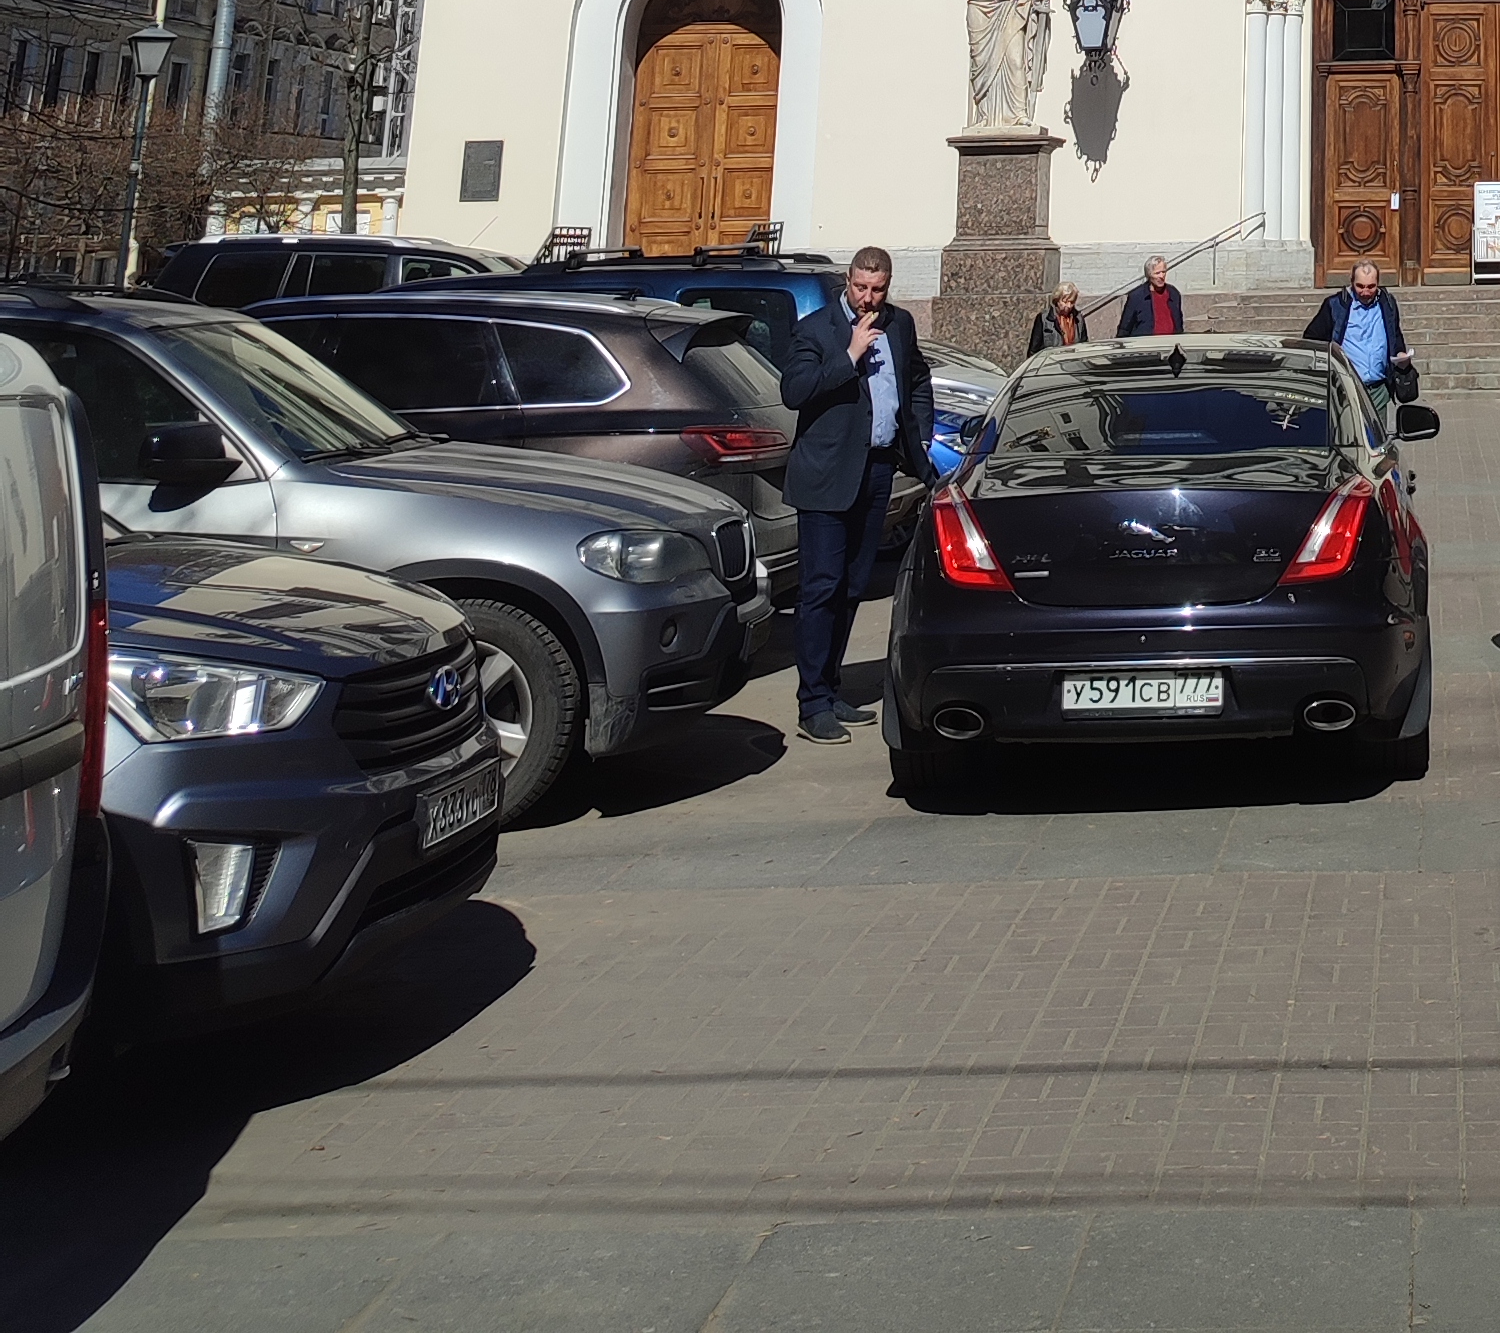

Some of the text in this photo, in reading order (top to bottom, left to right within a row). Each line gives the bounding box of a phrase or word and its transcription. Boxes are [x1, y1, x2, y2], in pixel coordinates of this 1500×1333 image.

[1109, 548, 1179, 559] JAGUAR
[1073, 672, 1216, 704] У591СВ 777
[1186, 694, 1205, 703] RUS
